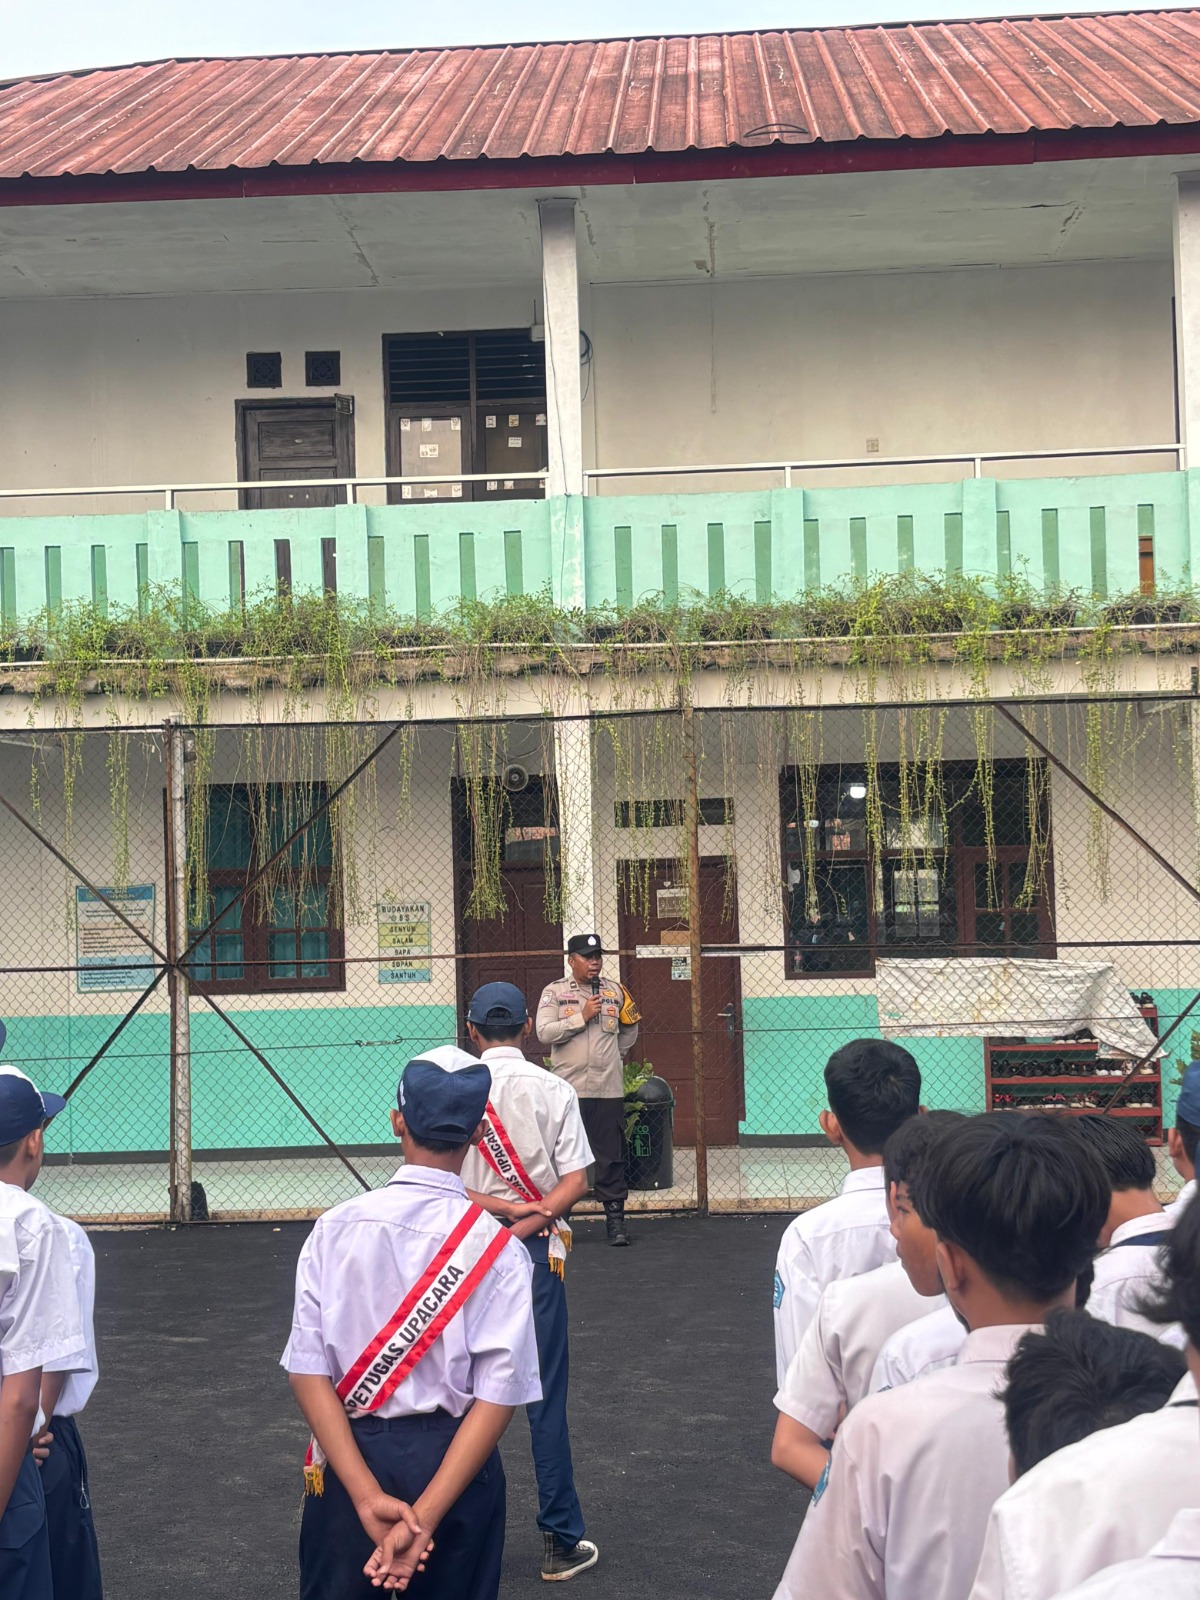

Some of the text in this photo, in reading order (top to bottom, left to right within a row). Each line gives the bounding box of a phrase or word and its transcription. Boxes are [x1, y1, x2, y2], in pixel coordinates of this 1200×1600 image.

[382, 905, 425, 913] BUDAYAKAN
[391, 972, 416, 980] SANTUN
[346, 1264, 465, 1408] PETUGAS UPACARA
